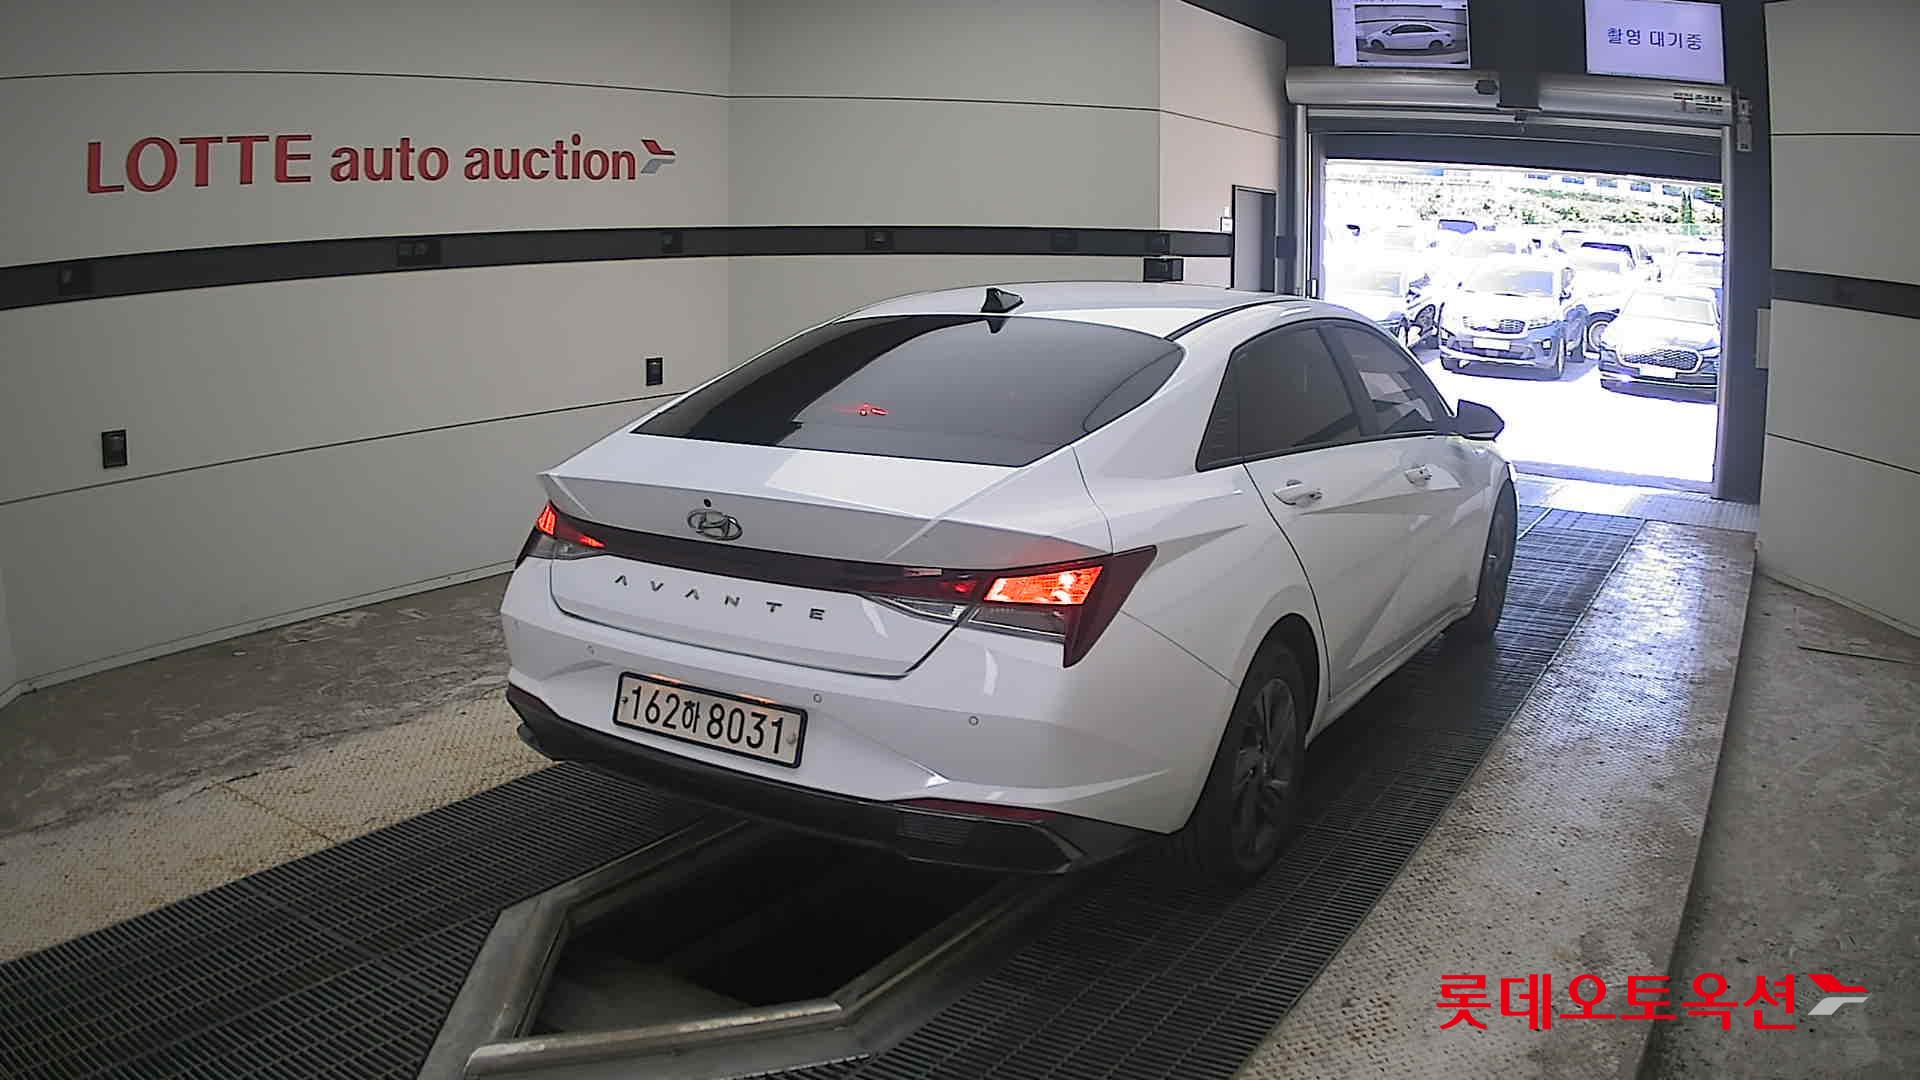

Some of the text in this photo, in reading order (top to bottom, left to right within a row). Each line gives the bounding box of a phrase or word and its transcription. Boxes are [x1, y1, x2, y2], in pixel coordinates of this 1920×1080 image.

[1607, 27, 1702, 51] 촬영 대기중
[86, 133, 637, 194] LOTTE auto auction
[615, 575, 825, 621] AVANTE
[706, 703, 784, 754] 8031
